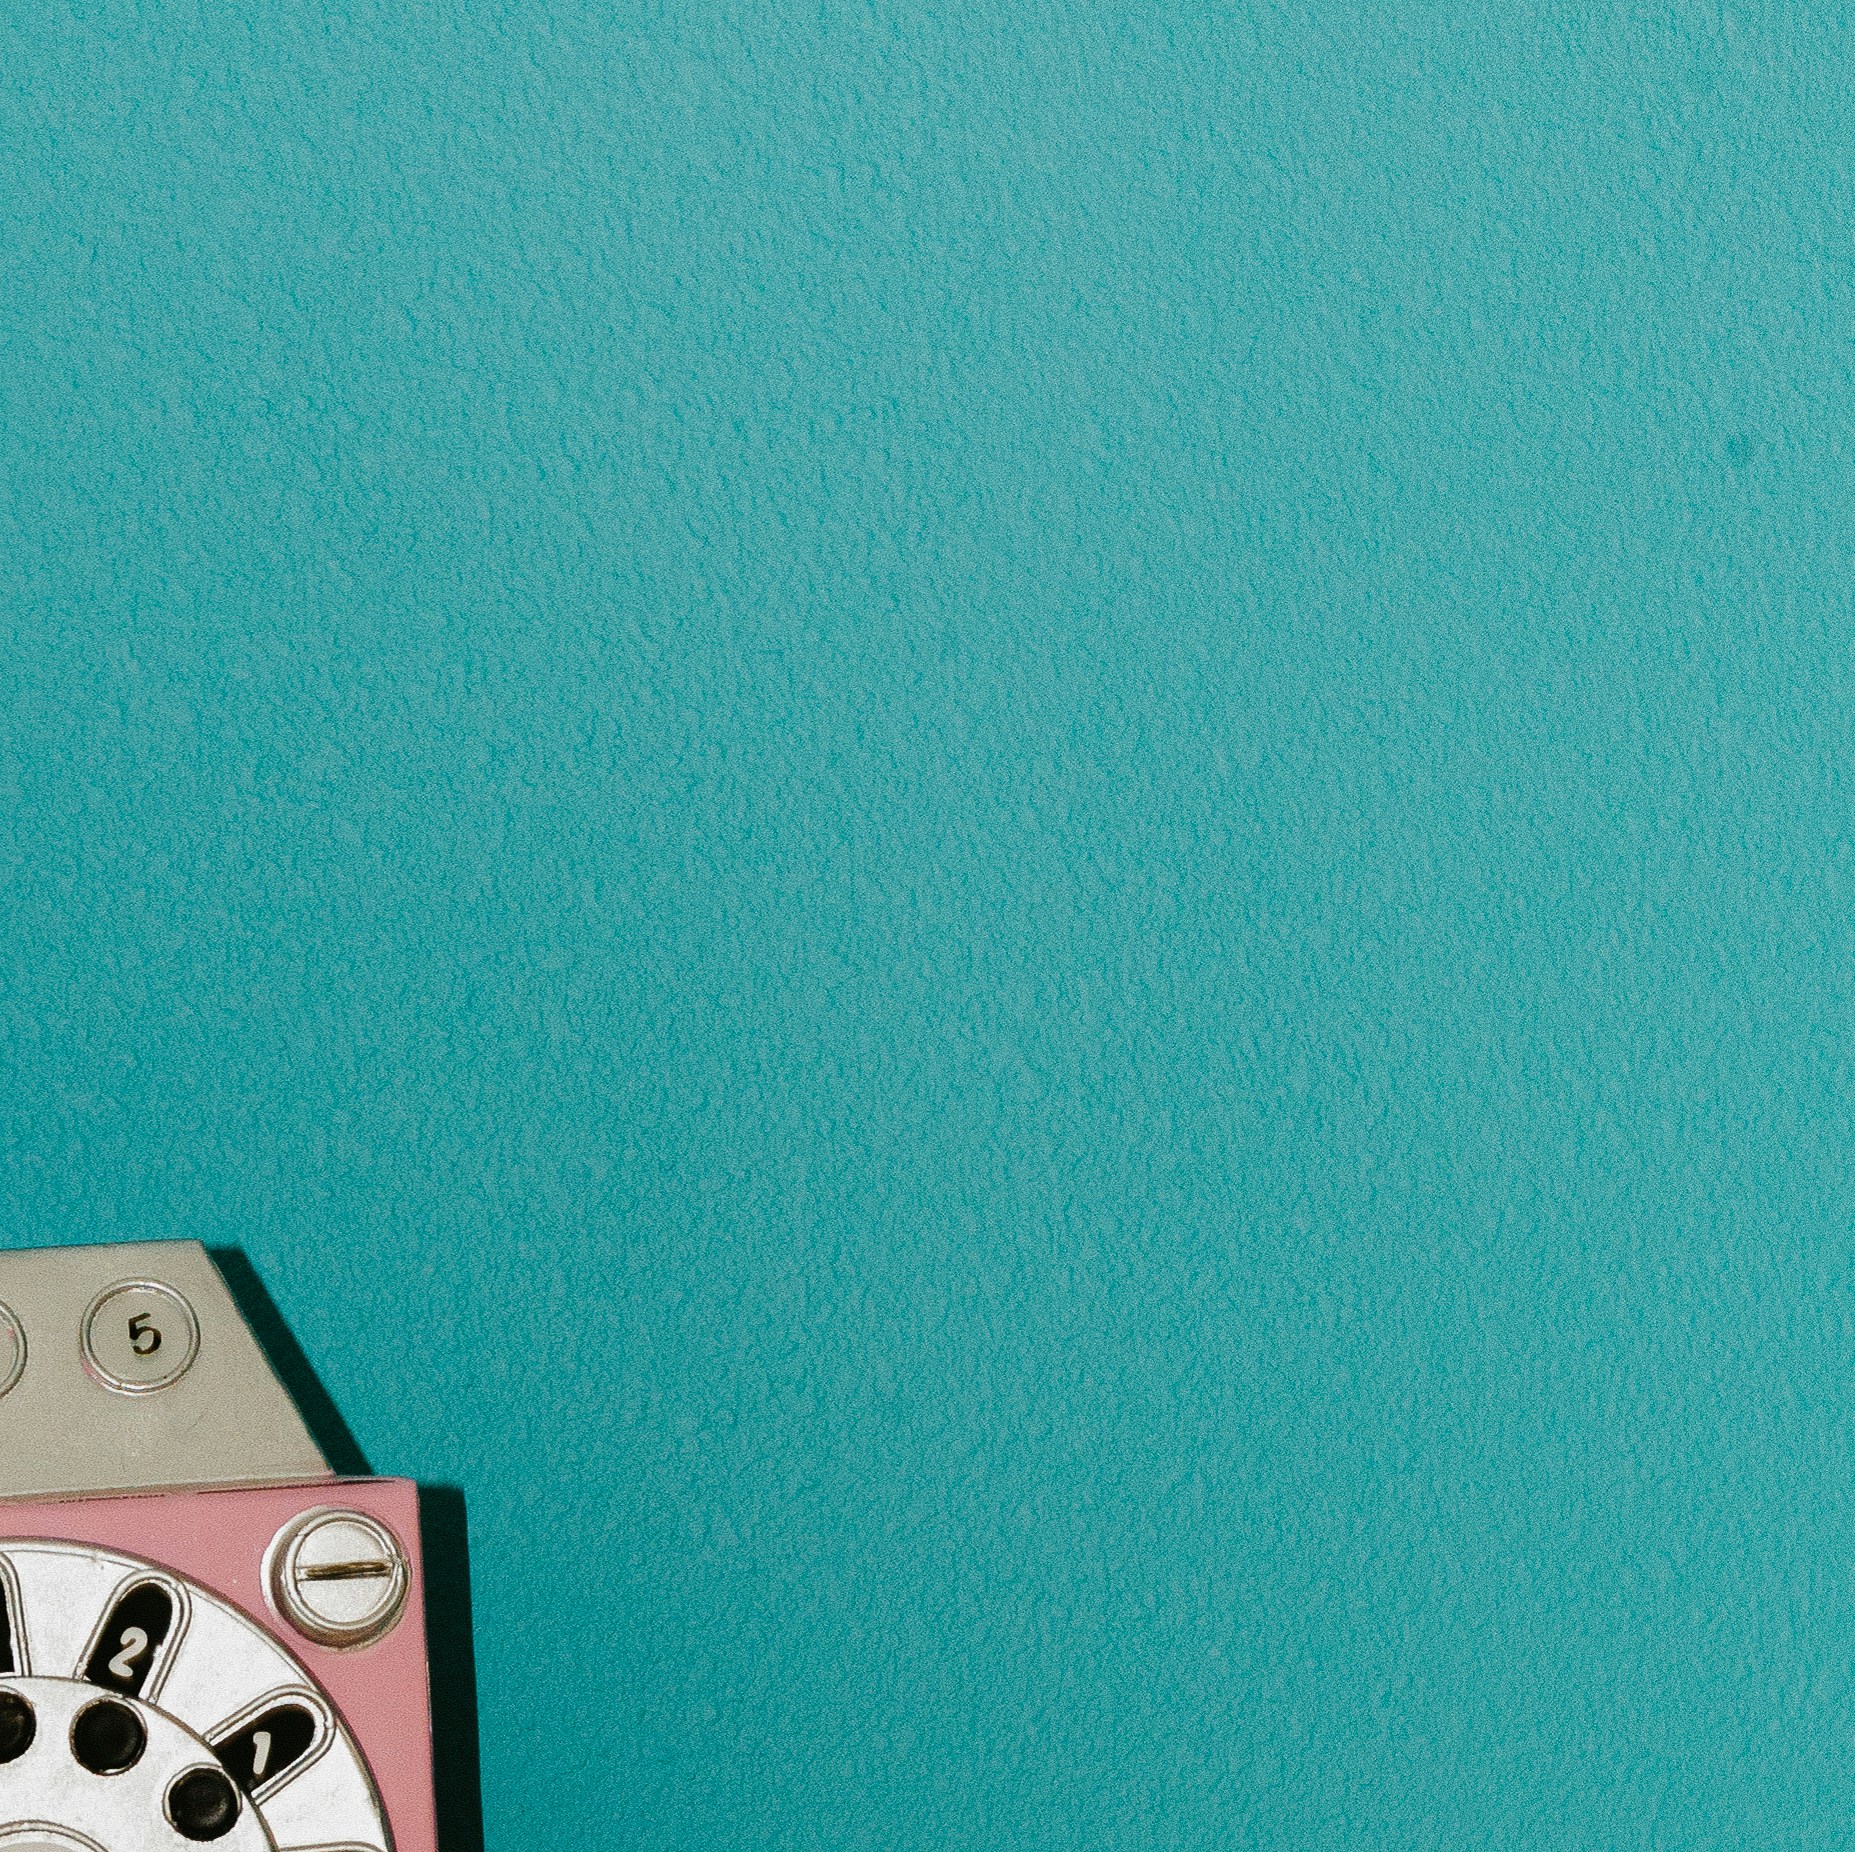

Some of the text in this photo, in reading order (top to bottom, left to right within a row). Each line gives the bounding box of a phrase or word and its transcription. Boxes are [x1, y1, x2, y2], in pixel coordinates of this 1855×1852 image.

[128, 1313, 162, 1356] 5
[108, 1628, 147, 1675] 2
[251, 1731, 273, 1776] 1
